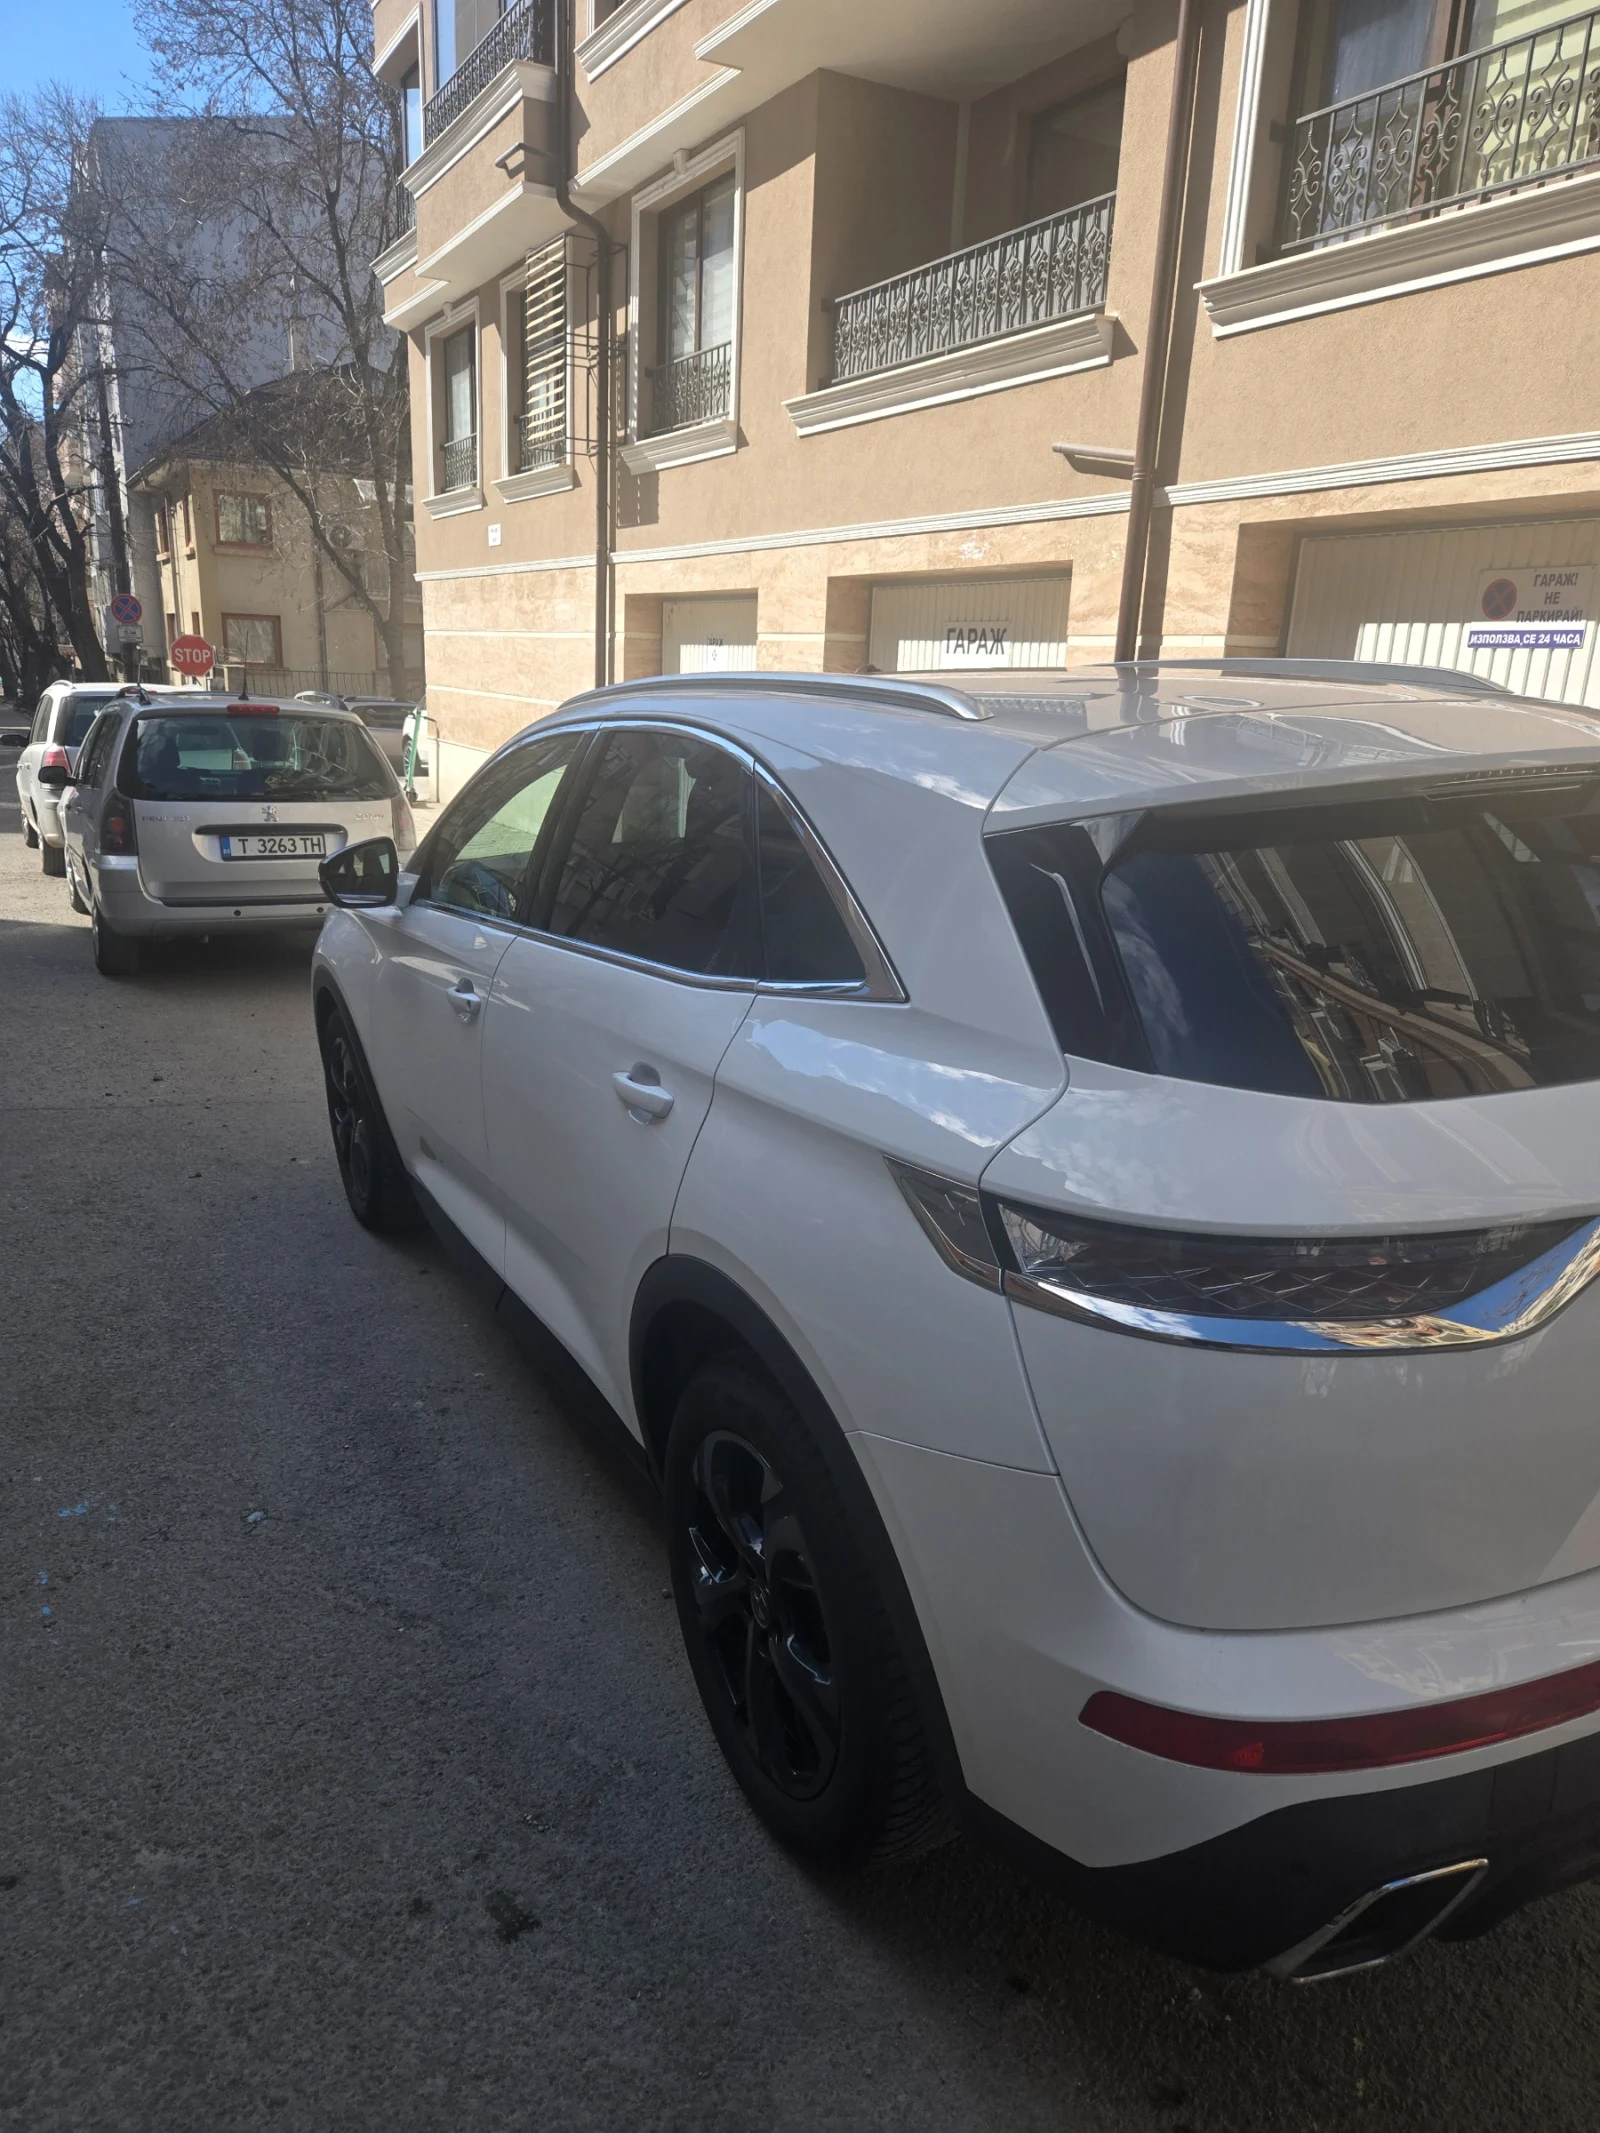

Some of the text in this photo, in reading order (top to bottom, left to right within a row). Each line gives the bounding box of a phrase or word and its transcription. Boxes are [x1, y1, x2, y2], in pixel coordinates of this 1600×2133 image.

[1533, 572, 1579, 587] ГАРАЖ!
[1544, 591, 1561, 605] НЕ
[1516, 606, 1584, 623] ПАРКИРАЙ!
[946, 627, 1007, 655] ГАРАЖ
[1523, 633, 1537, 644] СЕ
[1538, 633, 1551, 644] 24
[1553, 632, 1581, 645] ЧАСА
[174, 648, 211, 664] STOP
[238, 837, 322, 854] T 3263 TH
